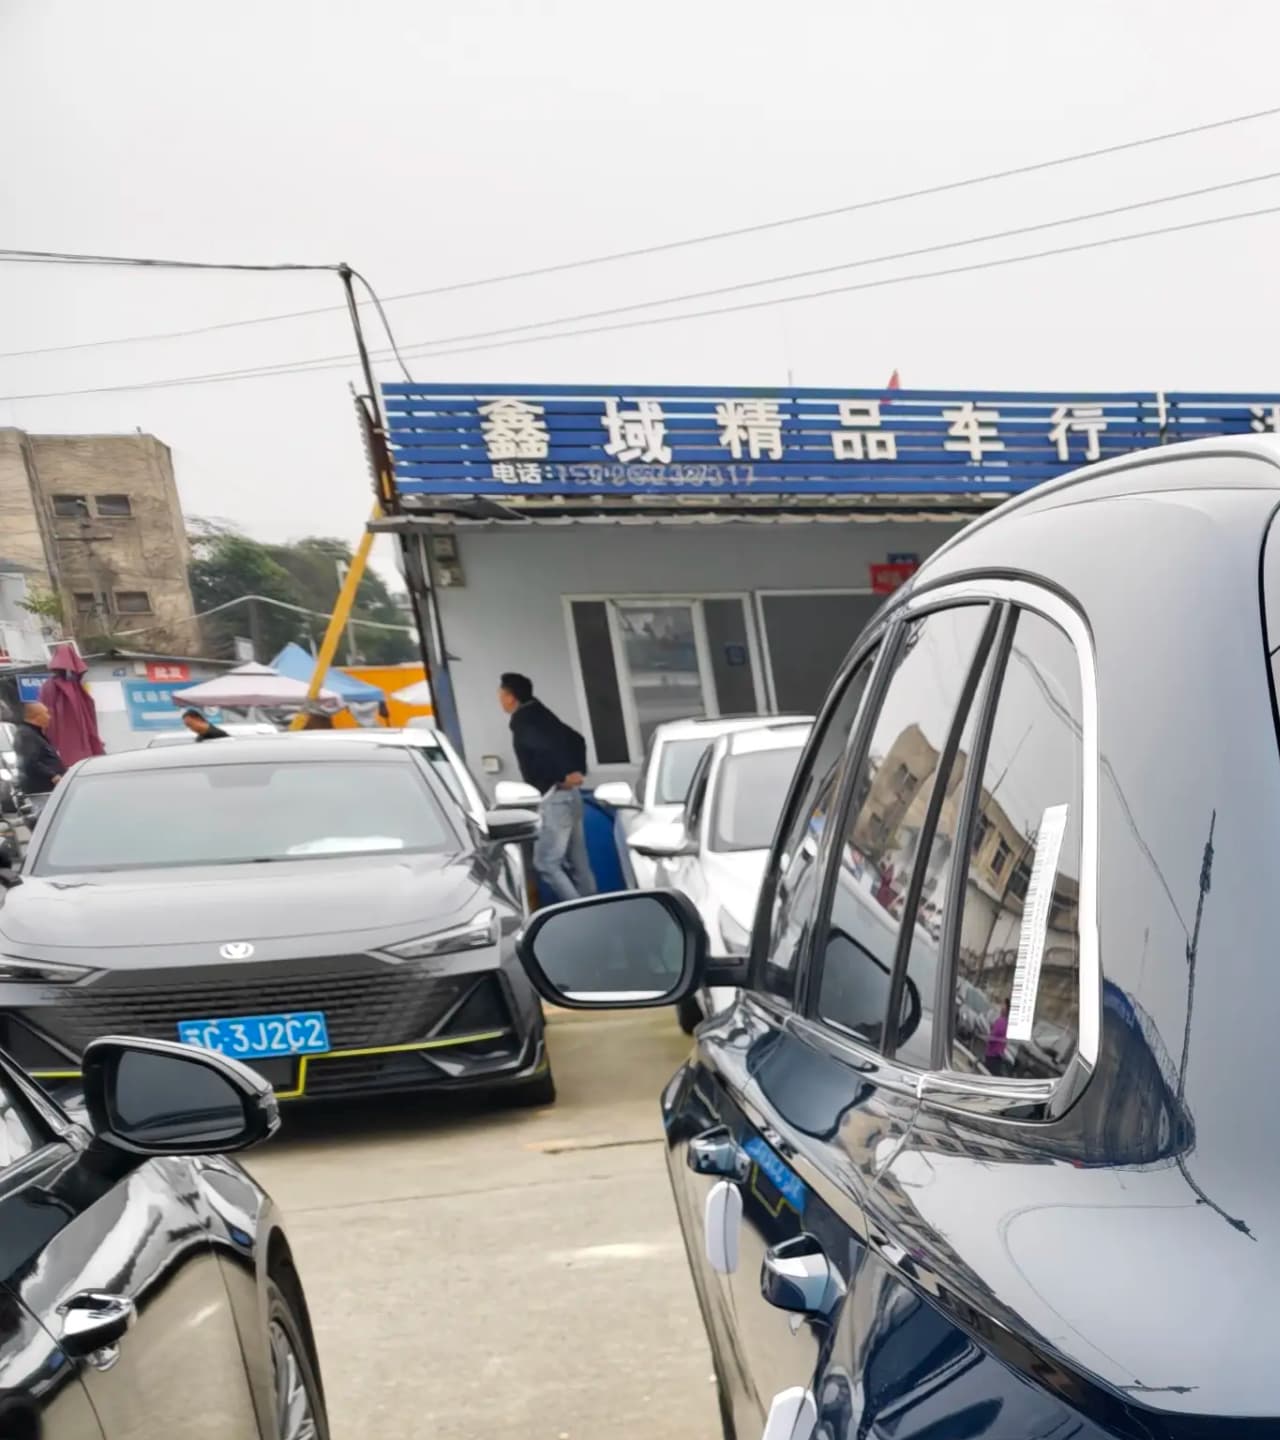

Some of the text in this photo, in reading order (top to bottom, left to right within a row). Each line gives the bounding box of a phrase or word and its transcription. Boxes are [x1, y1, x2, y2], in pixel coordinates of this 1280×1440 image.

[477, 398, 1108, 465] 鑫域精品车行
